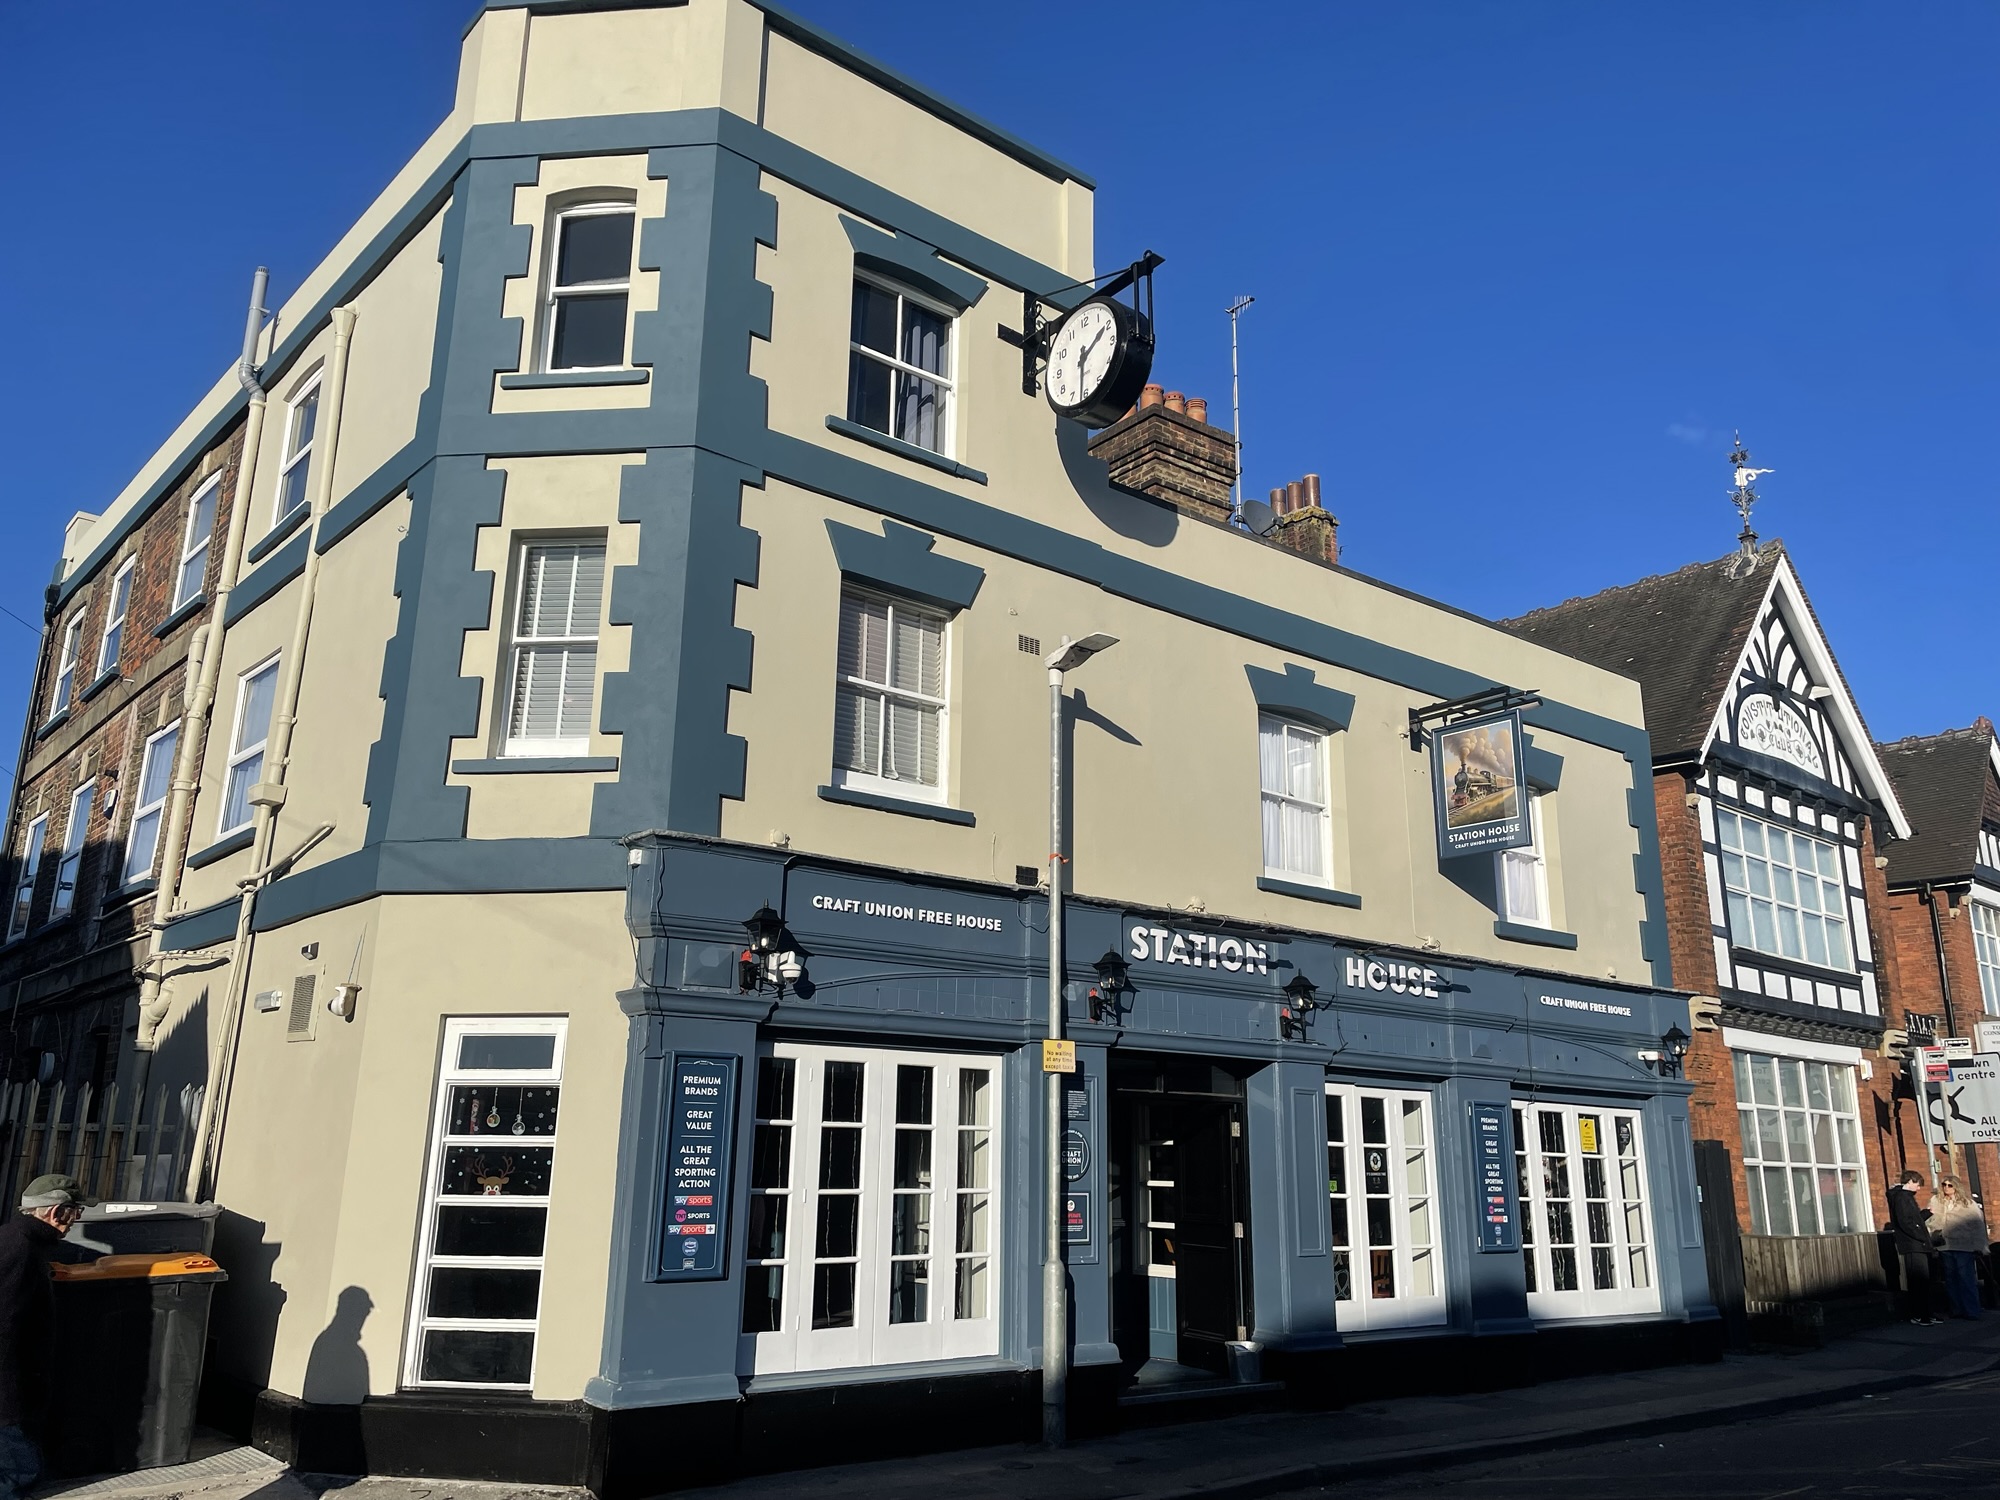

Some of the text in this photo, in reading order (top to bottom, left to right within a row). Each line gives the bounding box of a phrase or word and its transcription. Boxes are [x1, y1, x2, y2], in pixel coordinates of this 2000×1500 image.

[1081, 316, 1089, 328] 12
[1106, 320, 1112, 330] 2
[1069, 330, 1075, 341] 11
[1110, 335, 1115, 346] 3
[1059, 349, 1067, 360] 10
[1057, 369, 1062, 379] 9
[1061, 384, 1065, 394] 8
[1084, 388, 1088, 398] 6
[1070, 392, 1075, 401] 7
[1449, 824, 1520, 842] STATION HOUSE
[812, 895, 1002, 932] CRAFT UNION FREE HOUSE
[1130, 926, 1438, 998] STATION HOUSE
[1540, 996, 1631, 1016] CRAFT UNION FREE HOUSE
[1958, 1070, 1996, 1080] centre
[683, 1076, 721, 1085] PREMIUM
[685, 1087, 718, 1096] BRANDS
[687, 1110, 713, 1119] GREAT
[1981, 1116, 1997, 1125] All
[686, 1122, 712, 1130] VALUE
[680, 1146, 694, 1154] ALL
[683, 1157, 709, 1165] GREAT
[674, 1168, 716, 1177] SPORTING
[678, 1180, 710, 1188] ACTION
[675, 1196, 712, 1205] sky sports
[669, 1225, 681, 1234] sky
